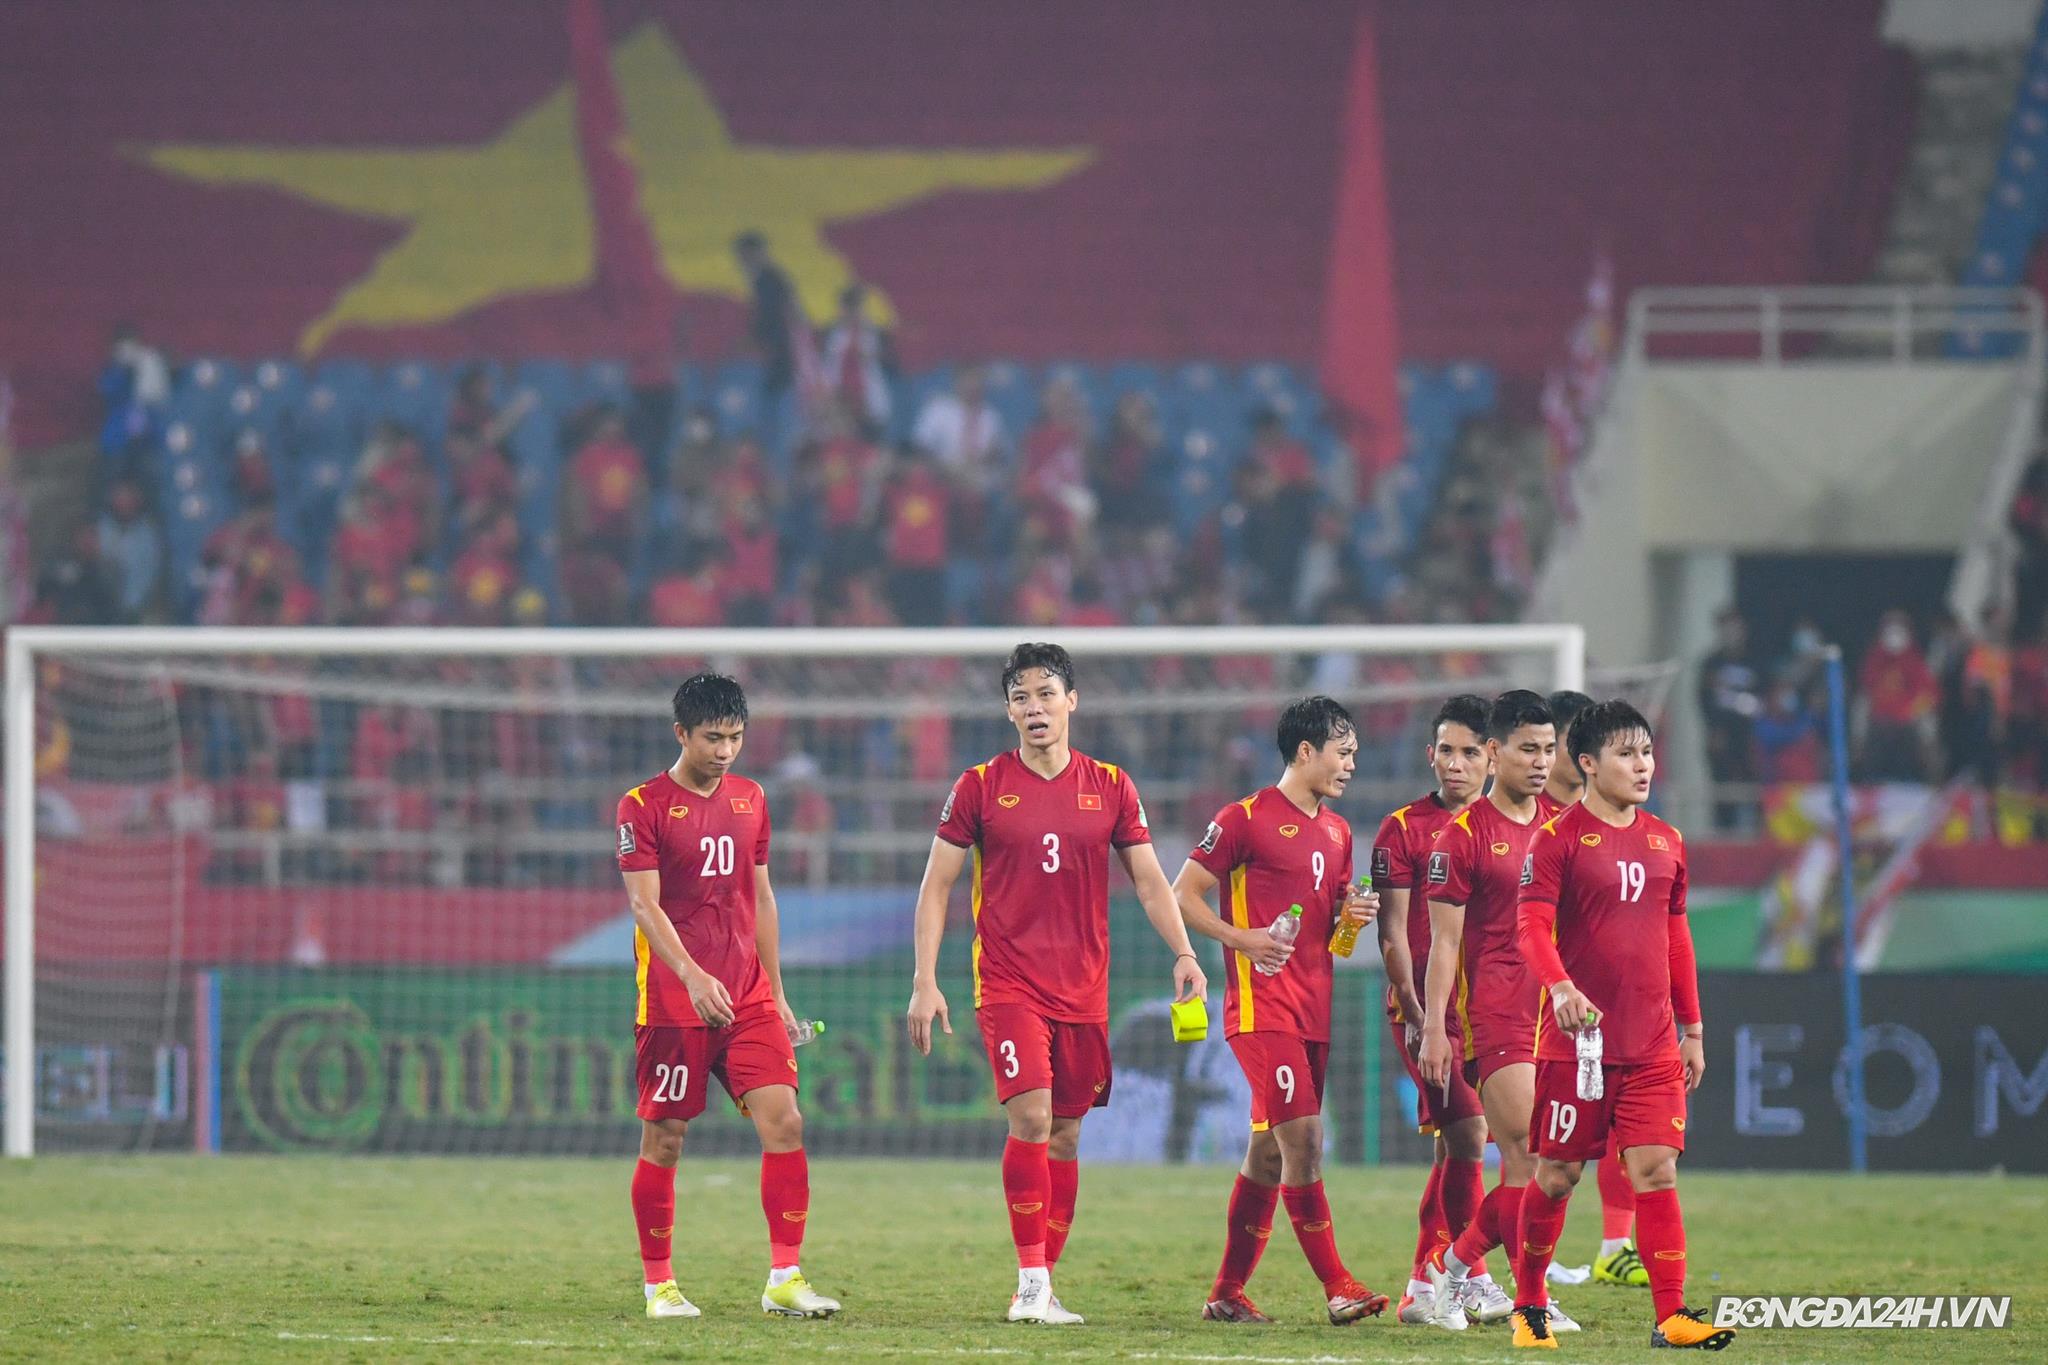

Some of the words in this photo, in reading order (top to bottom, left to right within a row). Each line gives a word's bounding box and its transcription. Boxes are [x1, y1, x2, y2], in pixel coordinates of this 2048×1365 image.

[699, 834, 735, 877] 20
[1041, 832, 1061, 874] 3
[1311, 850, 1326, 891] 9
[1616, 860, 1646, 903] 19
[999, 1039, 1020, 1079] 3
[651, 1063, 689, 1104] 20
[1275, 1064, 1295, 1104] 9
[1548, 1099, 1577, 1144] 19
